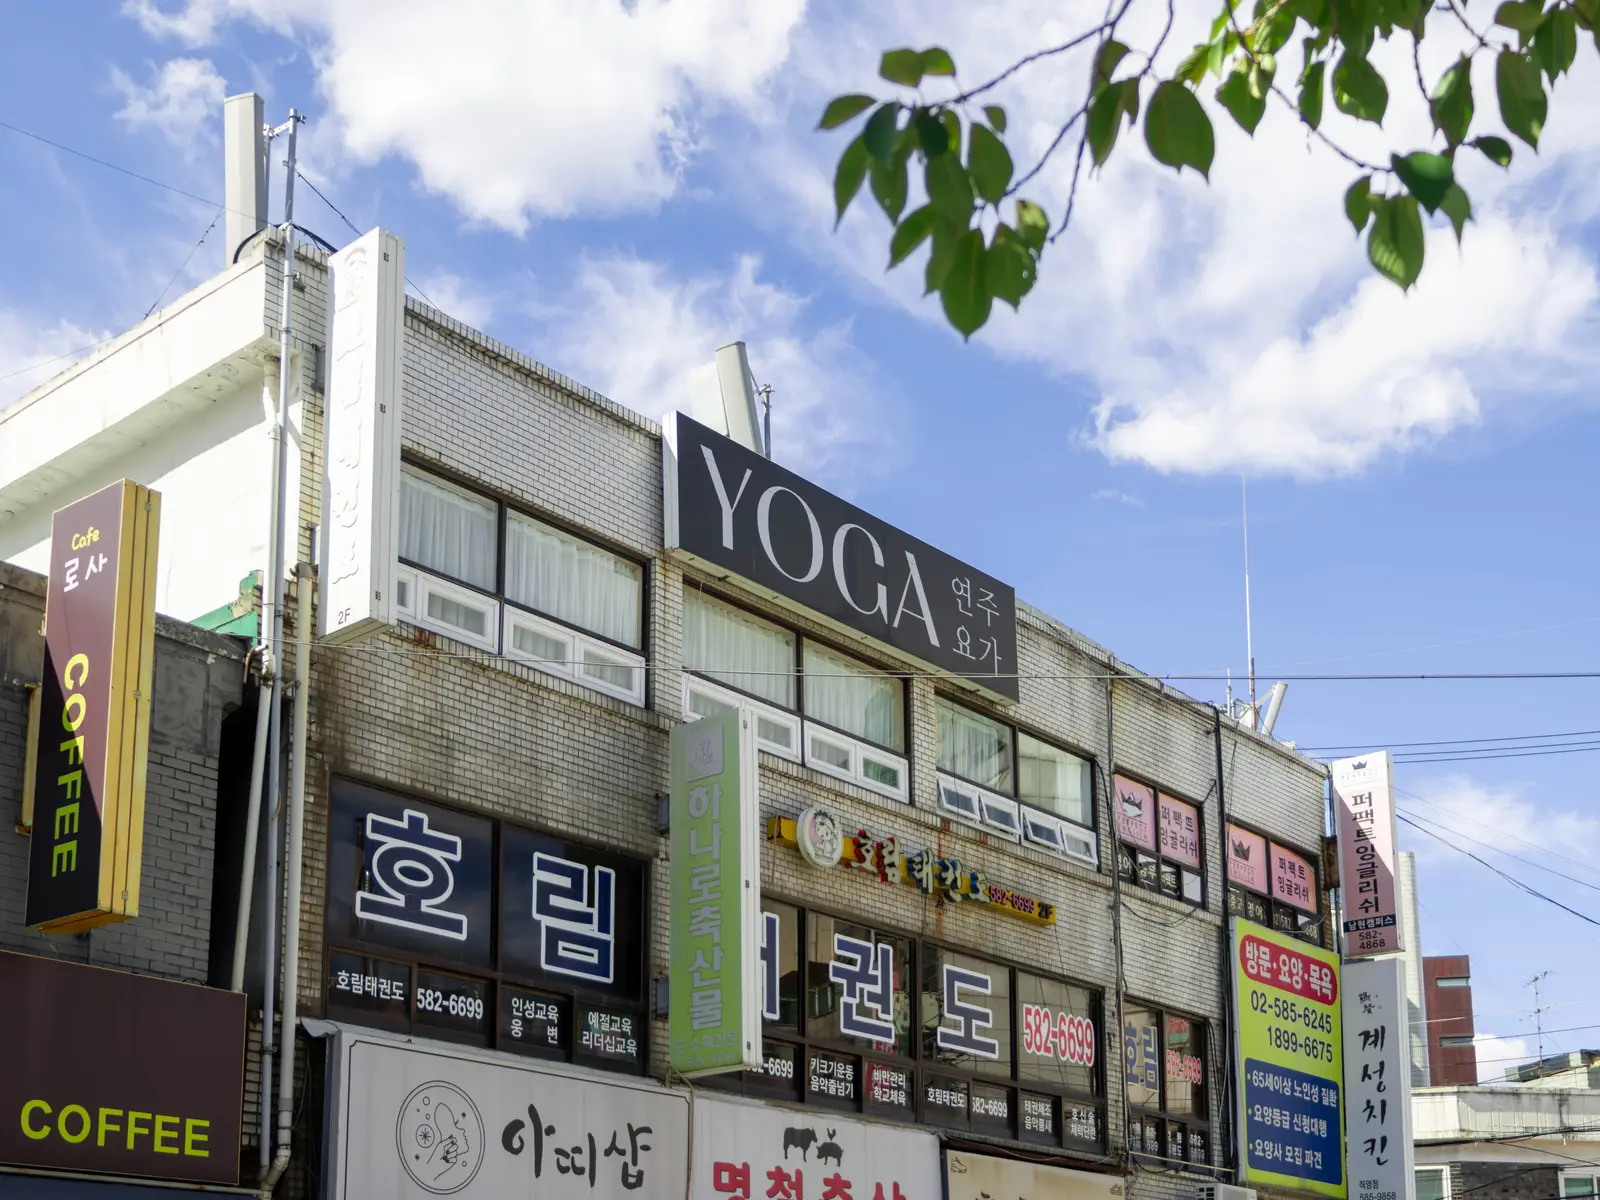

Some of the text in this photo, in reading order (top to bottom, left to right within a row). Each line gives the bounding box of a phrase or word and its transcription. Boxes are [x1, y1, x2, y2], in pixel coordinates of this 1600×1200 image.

[71, 526, 100, 551] Cafe
[700, 444, 940, 648] YOGA
[63, 552, 108, 593] 로사
[337, 607, 351, 625] 2F
[951, 576, 1000, 628] 연주
[952, 624, 1003, 676] 요가
[52, 653, 90, 878] COFFEE
[688, 782, 723, 1031] 하나로축산물
[989, 885, 1035, 914] 582-6699
[1037, 901, 1053, 920] 2F
[1358, 930, 1383, 942] 582-
[1358, 939, 1386, 951] 4868
[336, 969, 483, 1020] 호림태권도 582-6699
[511, 997, 559, 1023] 인성교육
[587, 1010, 632, 1036] 예절교육
[1251, 989, 1332, 1034] 02-585-6245
[582, 1031, 637, 1057] 리더십교육
[1022, 1004, 1095, 1067] 582-6699
[1267, 1025, 1333, 1063] 1899-6675
[811, 1058, 854, 1081] 키크기운동
[873, 1068, 906, 1088] 비만관리
[810, 1075, 854, 1098] 음악줄넘기
[873, 1085, 906, 1107] 학교체육
[927, 1086, 965, 1109] 호림태권도
[1252, 1070, 1337, 1108] 65세이상 노인성 질환
[1358, 1025, 1389, 1166] 계성치킨
[1024, 1099, 1052, 1117] 태권체조
[1253, 1104, 1327, 1138] 요양등급 신청대행
[20, 1099, 211, 1158] COFFEE
[1024, 1115, 1052, 1134] 음악품새
[1070, 1123, 1097, 1140] 체력단련
[1254, 1138, 1322, 1170] 요양사 모집 파견
